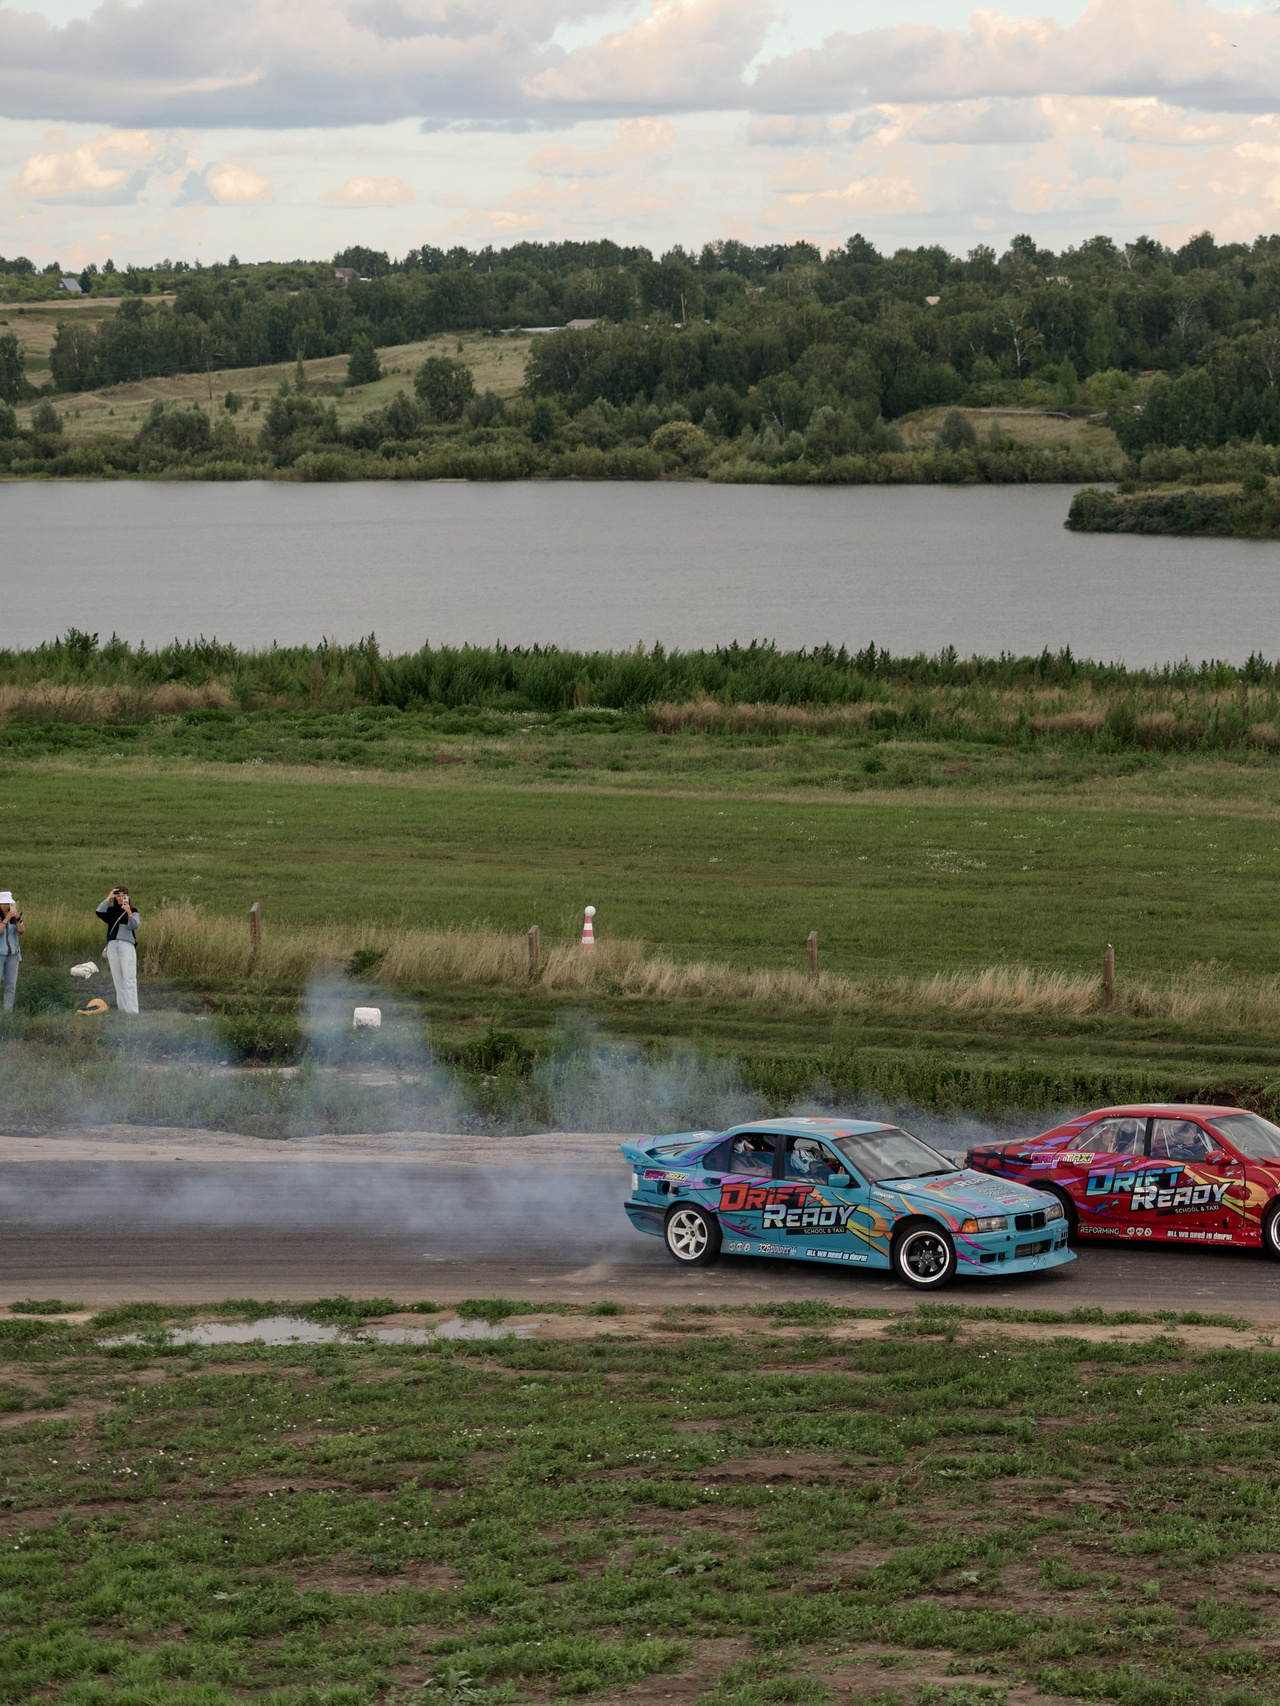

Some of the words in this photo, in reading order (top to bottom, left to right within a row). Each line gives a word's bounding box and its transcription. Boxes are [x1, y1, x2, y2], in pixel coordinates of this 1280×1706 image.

[1086, 1166, 1184, 1196] DRIFT
[720, 1184, 815, 1211] DRIFT
[1131, 1182, 1233, 1211] READY
[763, 1204, 857, 1229] READY
